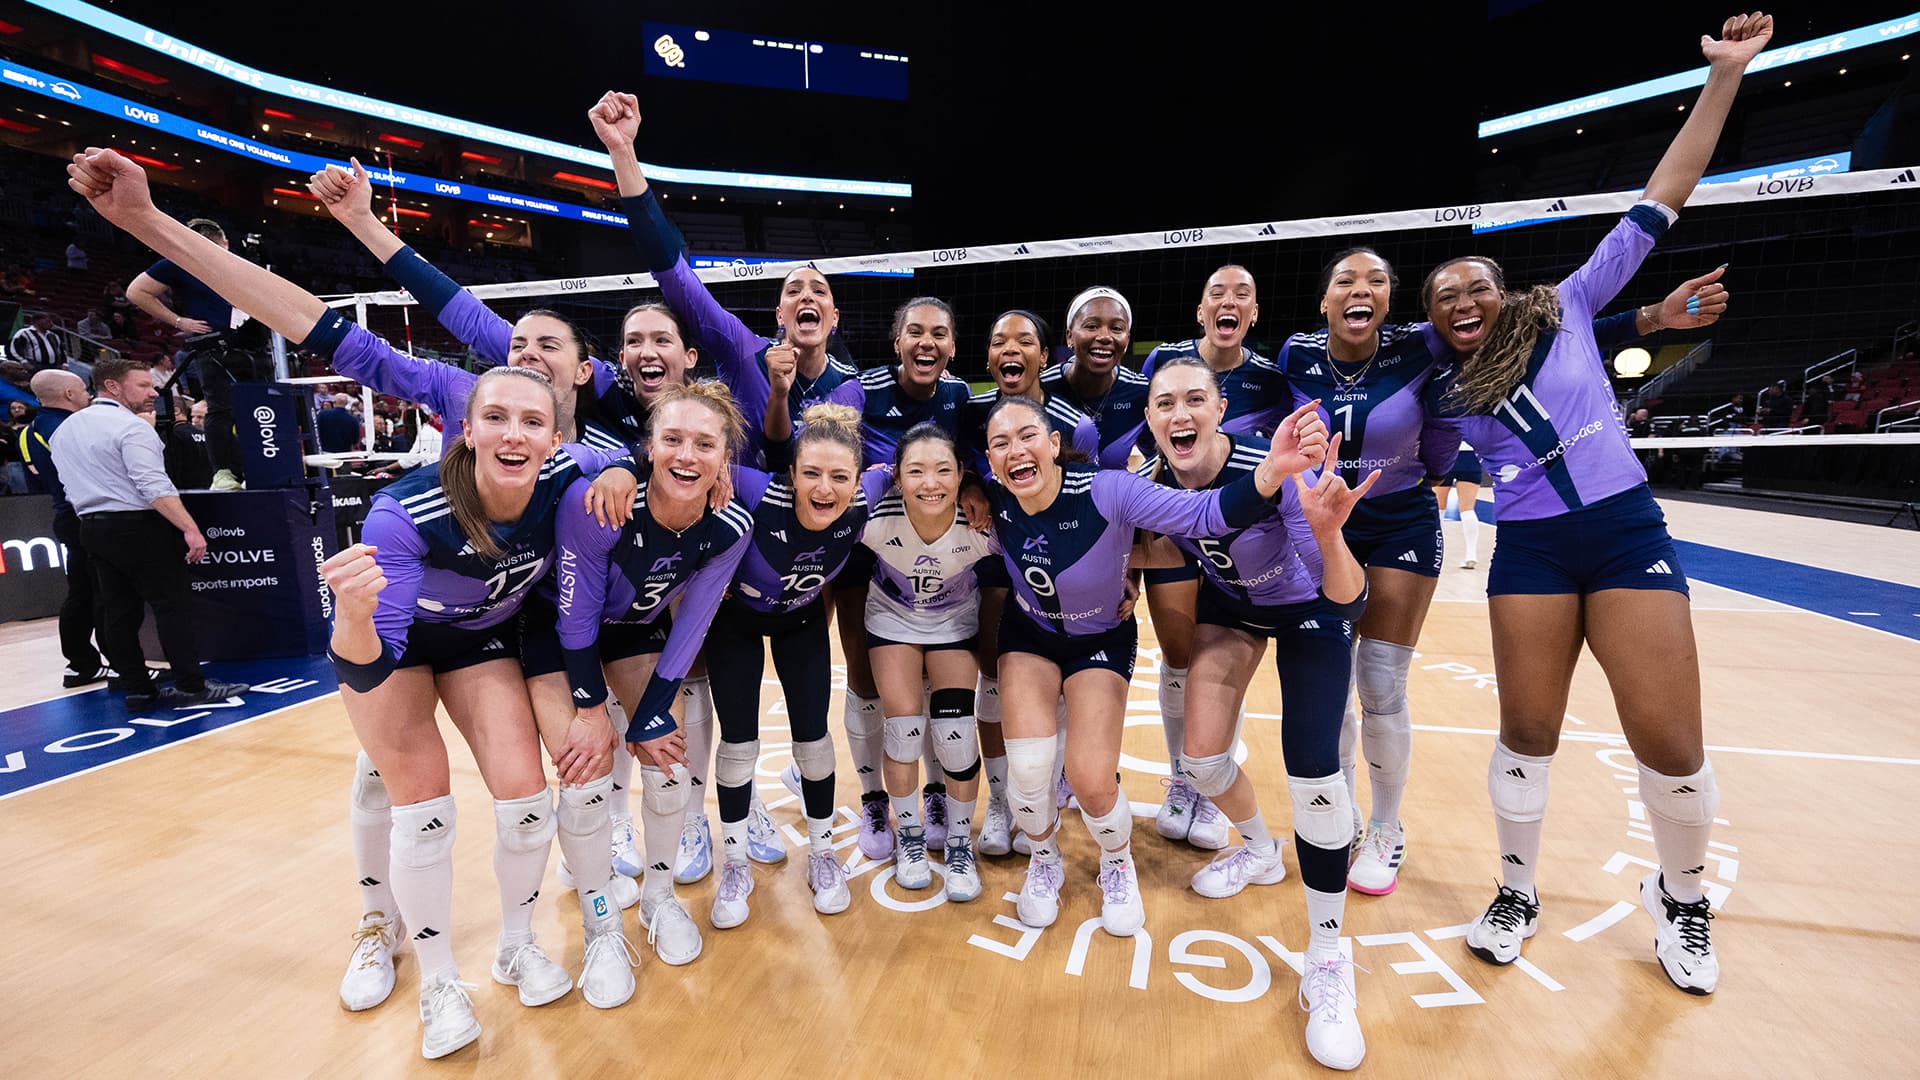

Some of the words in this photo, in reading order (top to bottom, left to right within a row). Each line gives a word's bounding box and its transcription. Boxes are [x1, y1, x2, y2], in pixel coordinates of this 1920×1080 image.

[1878, 19, 1919, 37] WE
[144, 30, 264, 87] UniFirst
[289, 84, 321, 100] WE
[326, 93, 397, 117] ALWAYS
[124, 105, 160, 124] LOVB
[197, 129, 228, 146] LEAGUE
[228, 139, 246, 151] ONE
[246, 143, 292, 164] VOLLEYBALL
[434, 183, 461, 195] LOVB
[1756, 176, 1815, 196] LOVB
[1434, 205, 1482, 223] LOVB
[1163, 229, 1204, 245] LOVB
[932, 248, 968, 263] LOVB
[1333, 393, 1368, 402] AUSTIN
[1492, 383, 1551, 433] 11
[253, 405, 280, 458] @lovb
[1334, 404, 1353, 441] 1
[1336, 455, 1401, 471] eadspace
[206, 527, 246, 539] @lovb
[186, 549, 276, 565] EVOLVE
[494, 550, 536, 571] AUSTIN
[1021, 553, 1052, 566] AUSTIN
[1199, 539, 1233, 569] 5
[644, 572, 677, 583] AUSTIN
[791, 564, 824, 572] AUSTIN
[913, 568, 941, 576] AUSTIN
[191, 579, 229, 592] sports
[230, 576, 279, 589] imports
[485, 557, 545, 600] 17
[560, 545, 577, 616] AUSTIN
[780, 573, 826, 592] 10
[906, 575, 944, 594] 15
[1024, 566, 1056, 597] 9
[632, 582, 670, 611] 3
